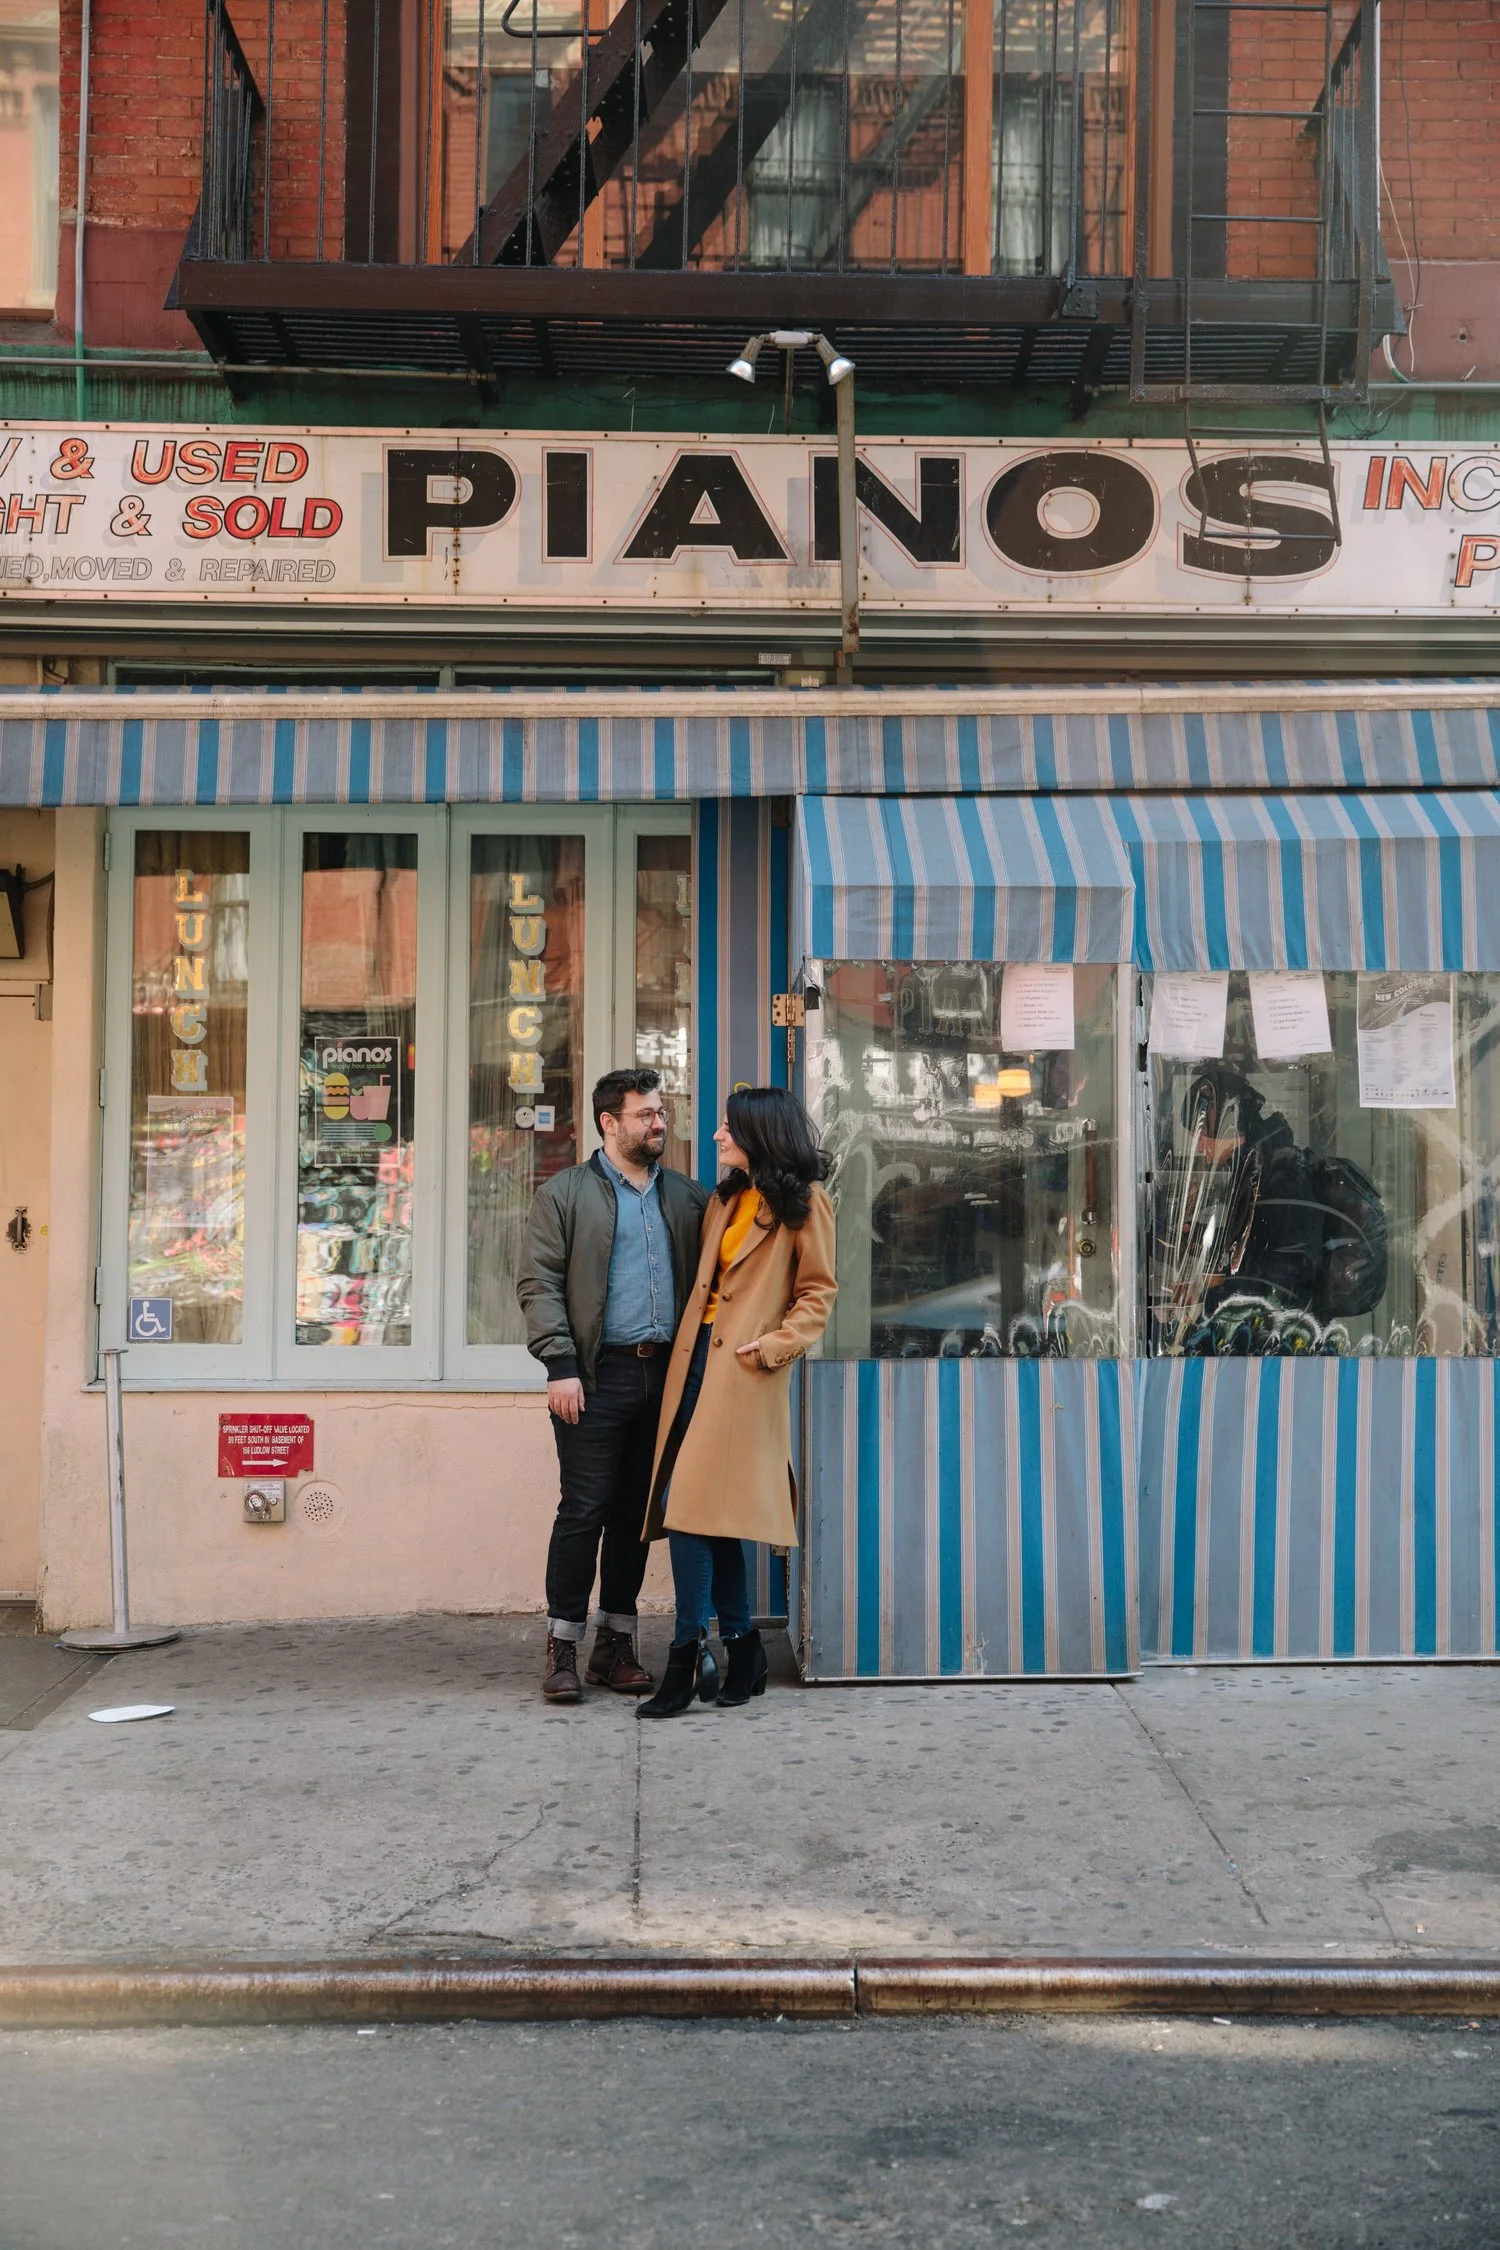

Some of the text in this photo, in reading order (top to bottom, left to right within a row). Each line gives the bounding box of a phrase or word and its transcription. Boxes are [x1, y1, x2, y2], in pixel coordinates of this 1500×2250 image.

[50, 438, 95, 480] &
[130, 440, 310, 485] USED
[0, 494, 343, 539] HT & SOLD
[384, 446, 1340, 581] PIANOS
[164, 558, 186, 582] &
[199, 558, 337, 583] REPAIRED
[172, 870, 209, 1091] LUNCH
[508, 873, 546, 1093] LUNCH
[1375, 993, 1391, 1001] NEW
[322, 1041, 393, 1069] pianos
[223, 1425, 310, 1433] SPRINKLER SHUT-OFF VALVE LOCATED
[235, 1436, 246, 1444] FEET
[248, 1436, 263, 1444] SOUTH
[265, 1436, 270, 1444] IN
[271, 1436, 296, 1444] BASEMENT
[297, 1436, 304, 1444] OF
[251, 1446, 270, 1454] LUDLOW
[271, 1446, 289, 1454] STREET
